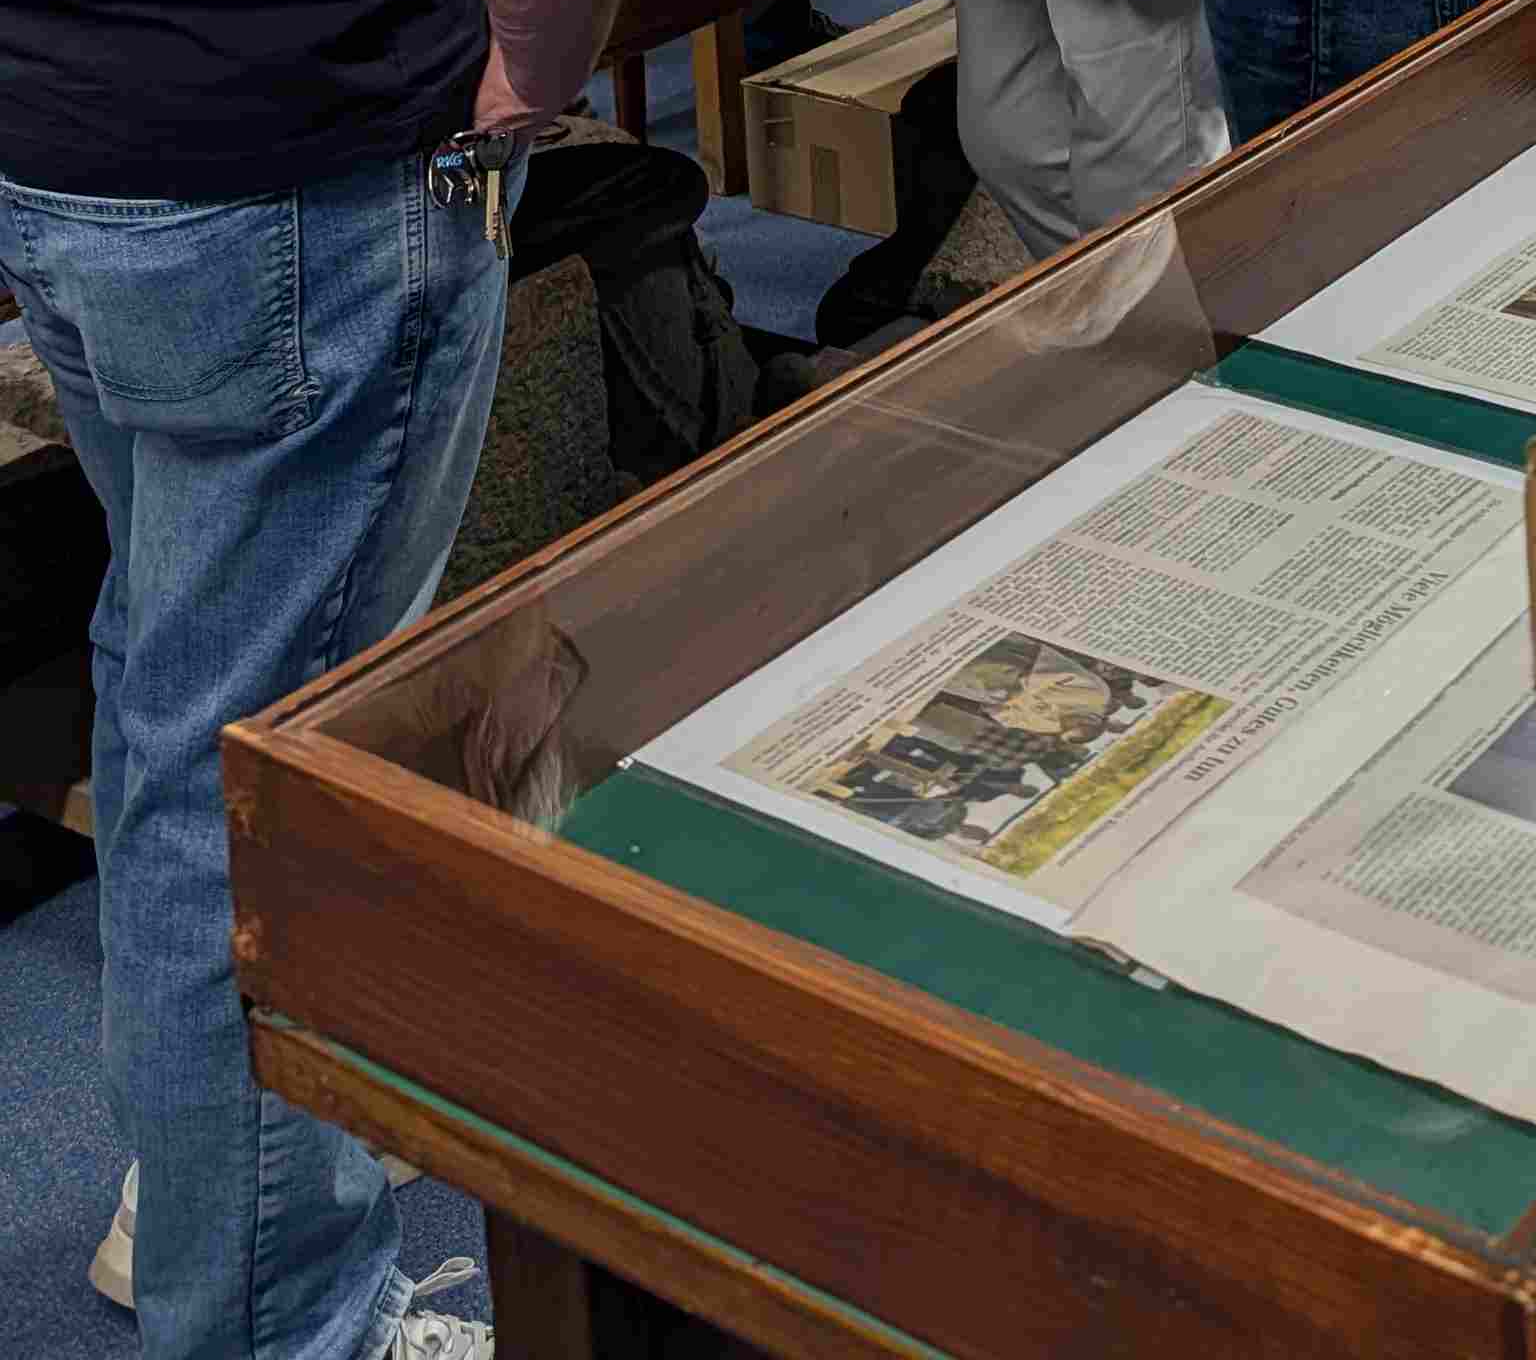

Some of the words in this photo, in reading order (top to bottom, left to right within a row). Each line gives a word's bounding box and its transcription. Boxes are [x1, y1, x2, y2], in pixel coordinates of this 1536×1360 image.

[1400, 571, 1449, 602] Viele
[1240, 695, 1299, 735] Gutes
[1216, 735, 1243, 755] zu
[1183, 755, 1225, 782] tun
